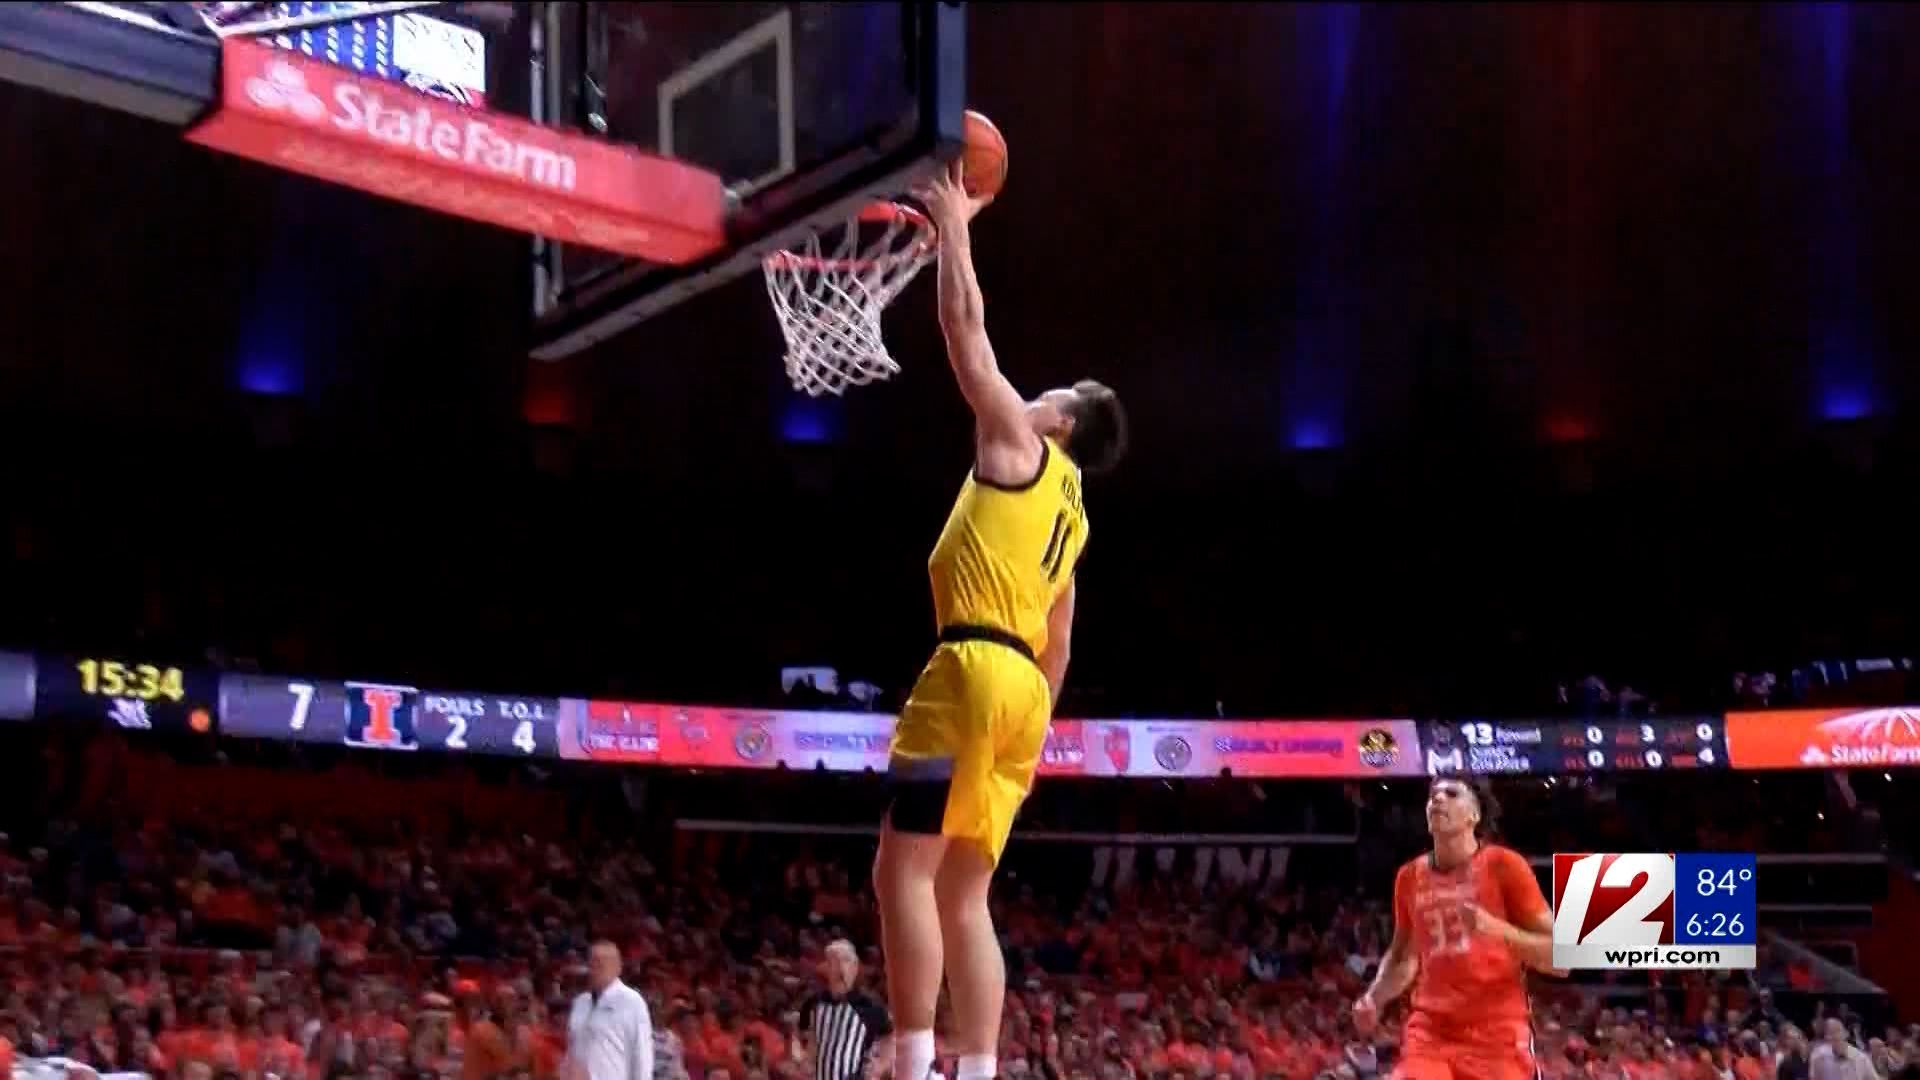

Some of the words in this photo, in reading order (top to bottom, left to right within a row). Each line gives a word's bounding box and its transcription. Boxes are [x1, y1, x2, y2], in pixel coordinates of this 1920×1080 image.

[1041, 508, 1073, 583] 11
[78, 660, 184, 699] 15:34
[287, 683, 313, 730] 7
[424, 696, 485, 717] FOULS
[445, 715, 468, 748] 2
[512, 720, 537, 754] 4
[1461, 722, 1494, 745] 13
[1586, 725, 1603, 744] 0
[1696, 722, 1713, 741] 0
[1587, 749, 1604, 767] 0
[1645, 749, 1662, 768] 0
